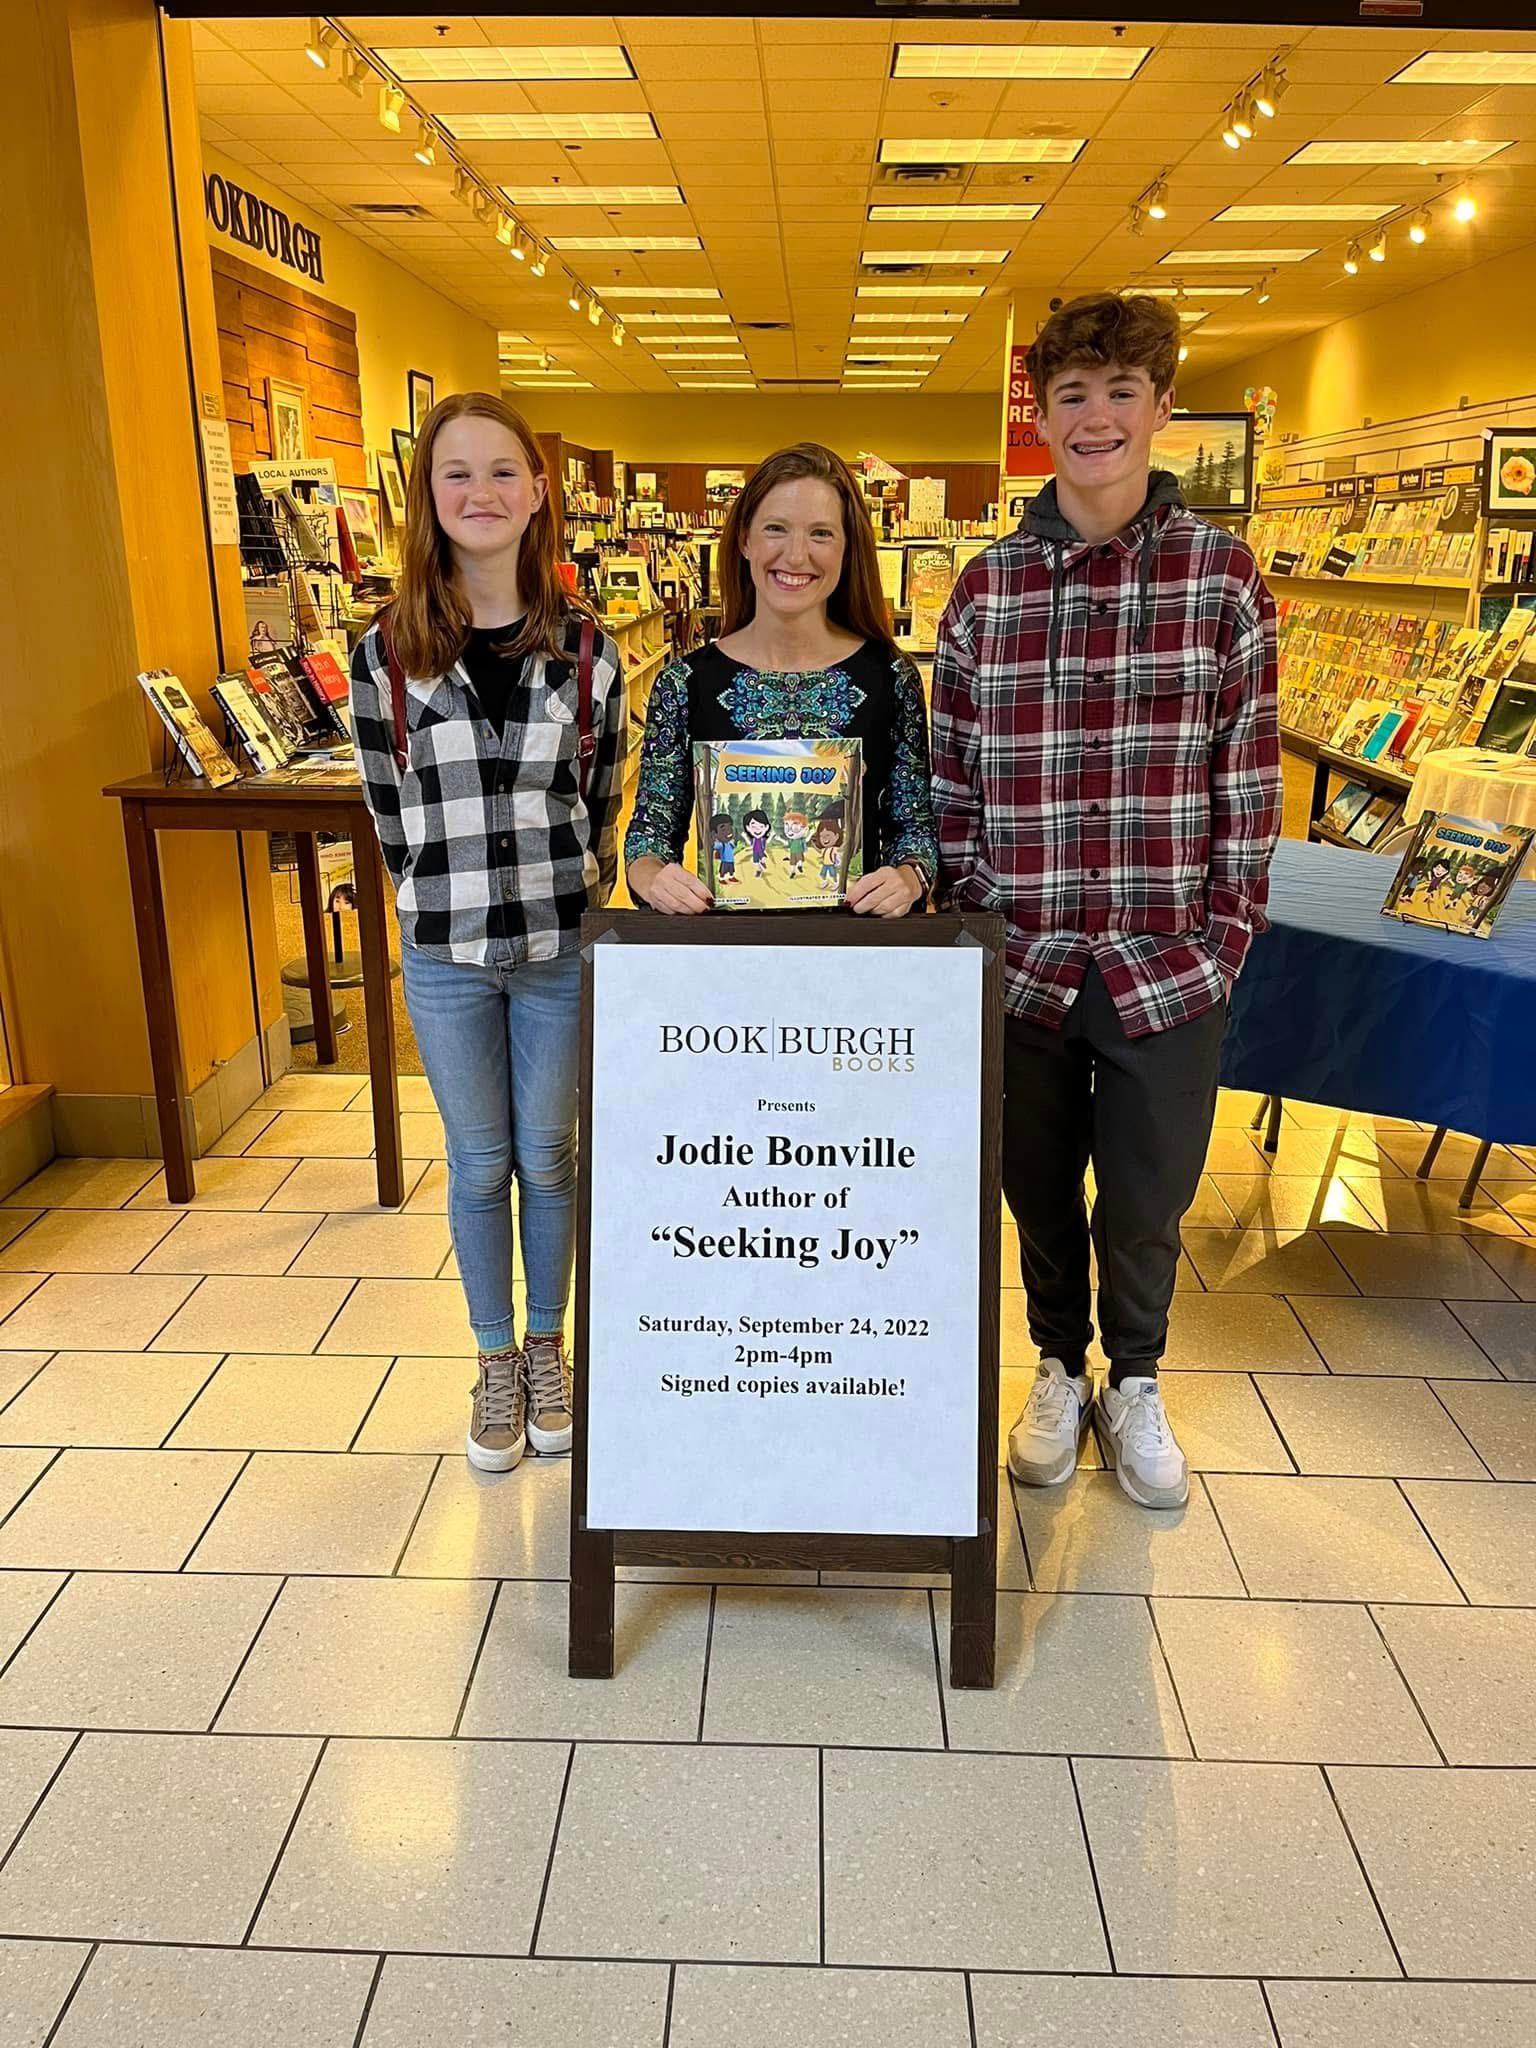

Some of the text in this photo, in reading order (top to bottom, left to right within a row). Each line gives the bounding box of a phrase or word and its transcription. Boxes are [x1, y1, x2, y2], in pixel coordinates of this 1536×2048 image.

[202, 170, 325, 284] OKBURGH
[1008, 430, 1050, 447] LOC
[258, 467, 329, 479] LOCAL AUTHORS
[725, 764, 837, 785] SEEKING JOY
[1435, 827, 1512, 855] SEEKING JOY
[659, 1026, 916, 1055] BOOK BURGH
[833, 1057, 916, 1073] BOOKS
[757, 1099, 816, 1113] Presents
[656, 1135, 916, 1169] Jodie Bonville
[722, 1186, 852, 1209] Author of
[651, 1226, 919, 1270] “Seeking Joy”
[638, 1315, 930, 1339] Saturday, September 24, 2022
[734, 1345, 833, 1369] 2pm-4pm
[661, 1374, 905, 1399] Signed copies available!
